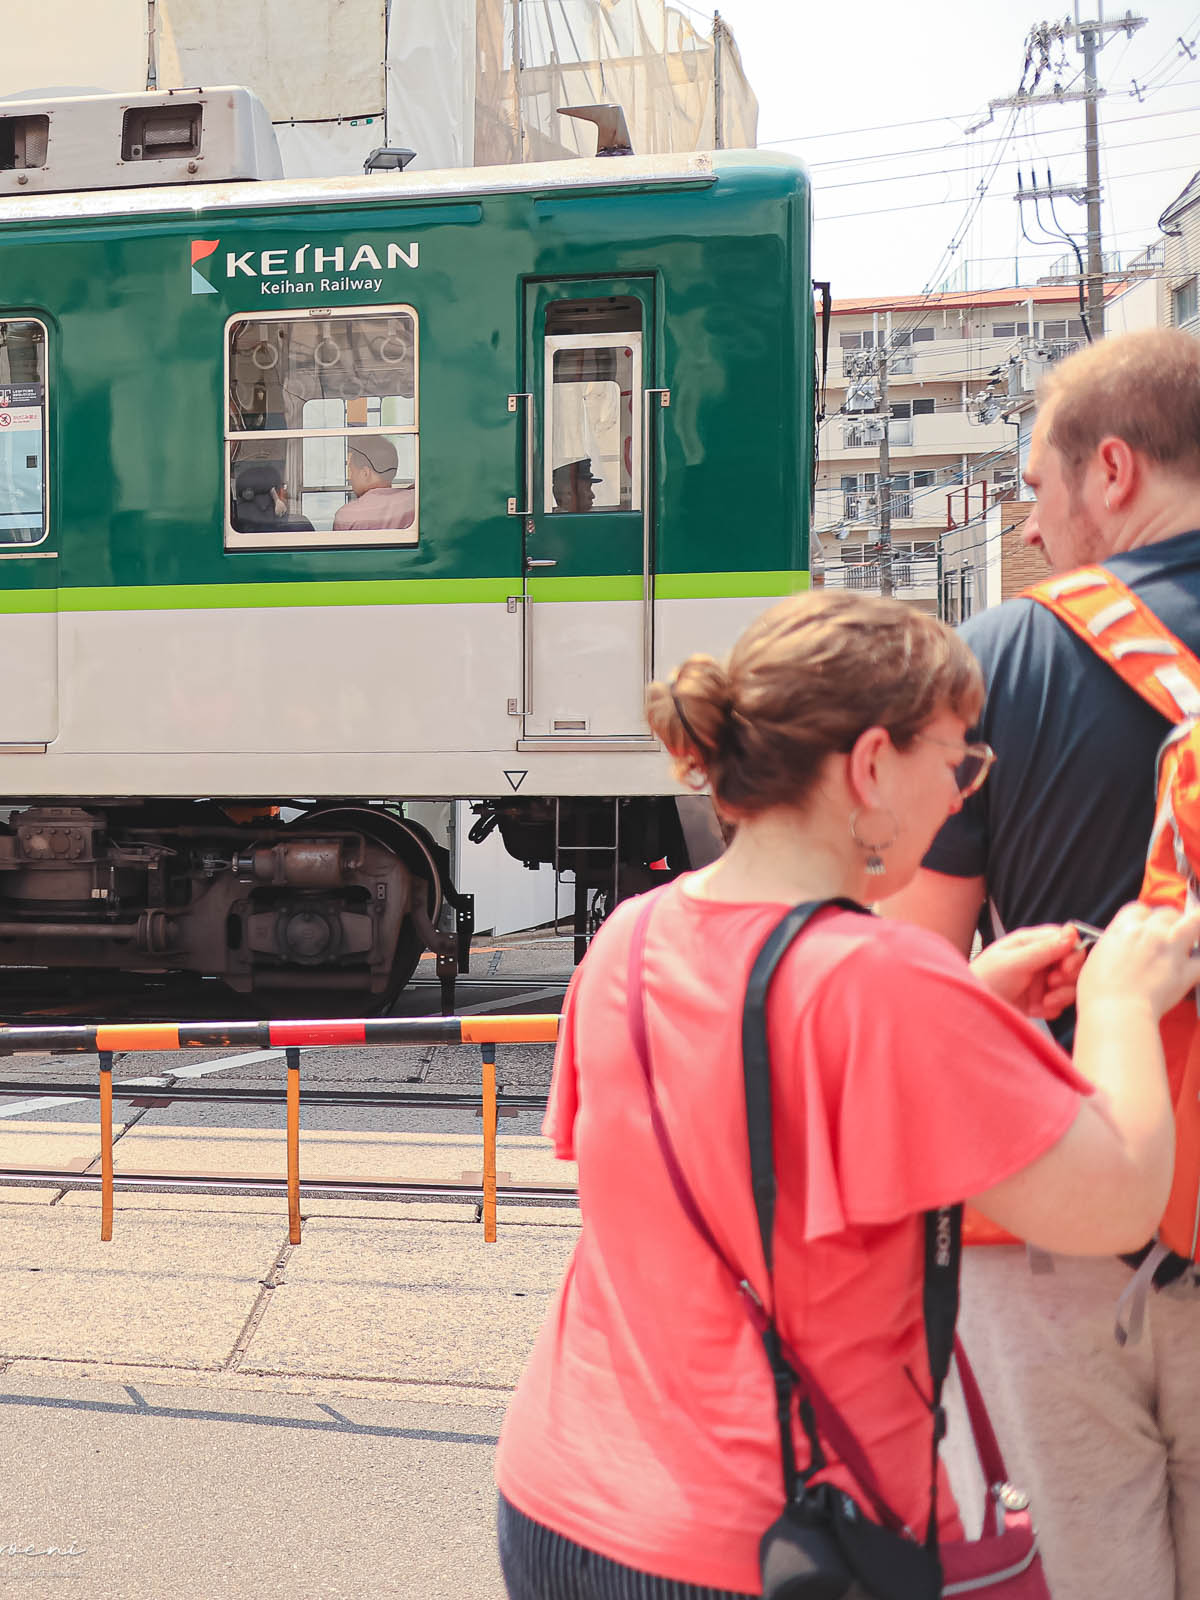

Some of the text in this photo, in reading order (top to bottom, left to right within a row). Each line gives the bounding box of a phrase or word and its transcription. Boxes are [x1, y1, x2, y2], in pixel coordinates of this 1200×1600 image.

[226, 242, 419, 278] KEIHAN
[261, 277, 383, 295] Keihan Railway
